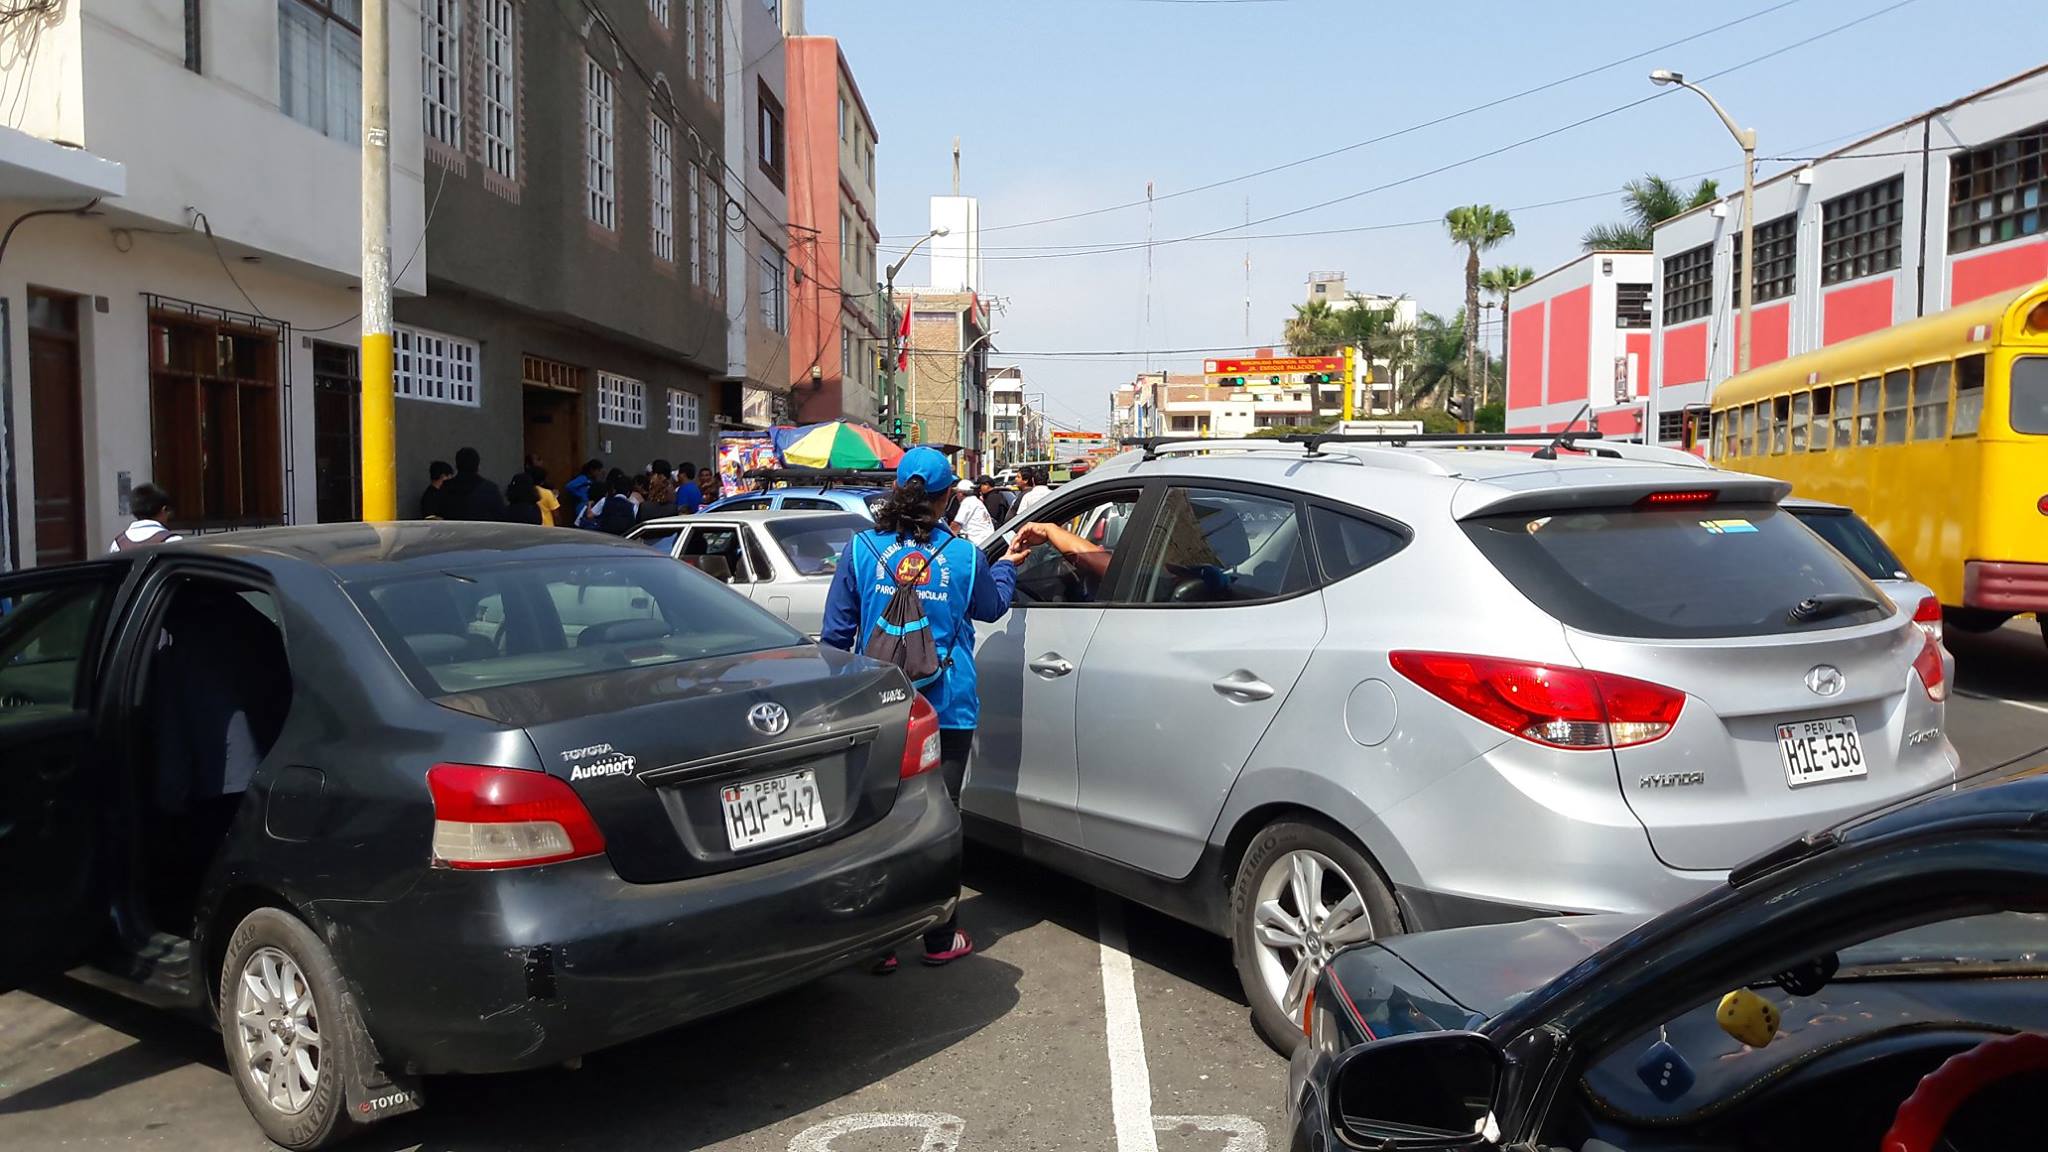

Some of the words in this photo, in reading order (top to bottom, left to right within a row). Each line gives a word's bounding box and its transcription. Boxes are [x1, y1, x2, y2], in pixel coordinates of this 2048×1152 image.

[1804, 722, 1832, 736] PERU
[560, 743, 614, 761] TOYOTA
[1785, 732, 1861, 775] H1E-538
[570, 757, 634, 782] Autonort
[1640, 771, 1705, 788] HYUNDAI
[754, 778, 787, 796] PERU
[730, 785, 814, 839] H1F-547
[1236, 837, 1277, 914] OPTIMO
